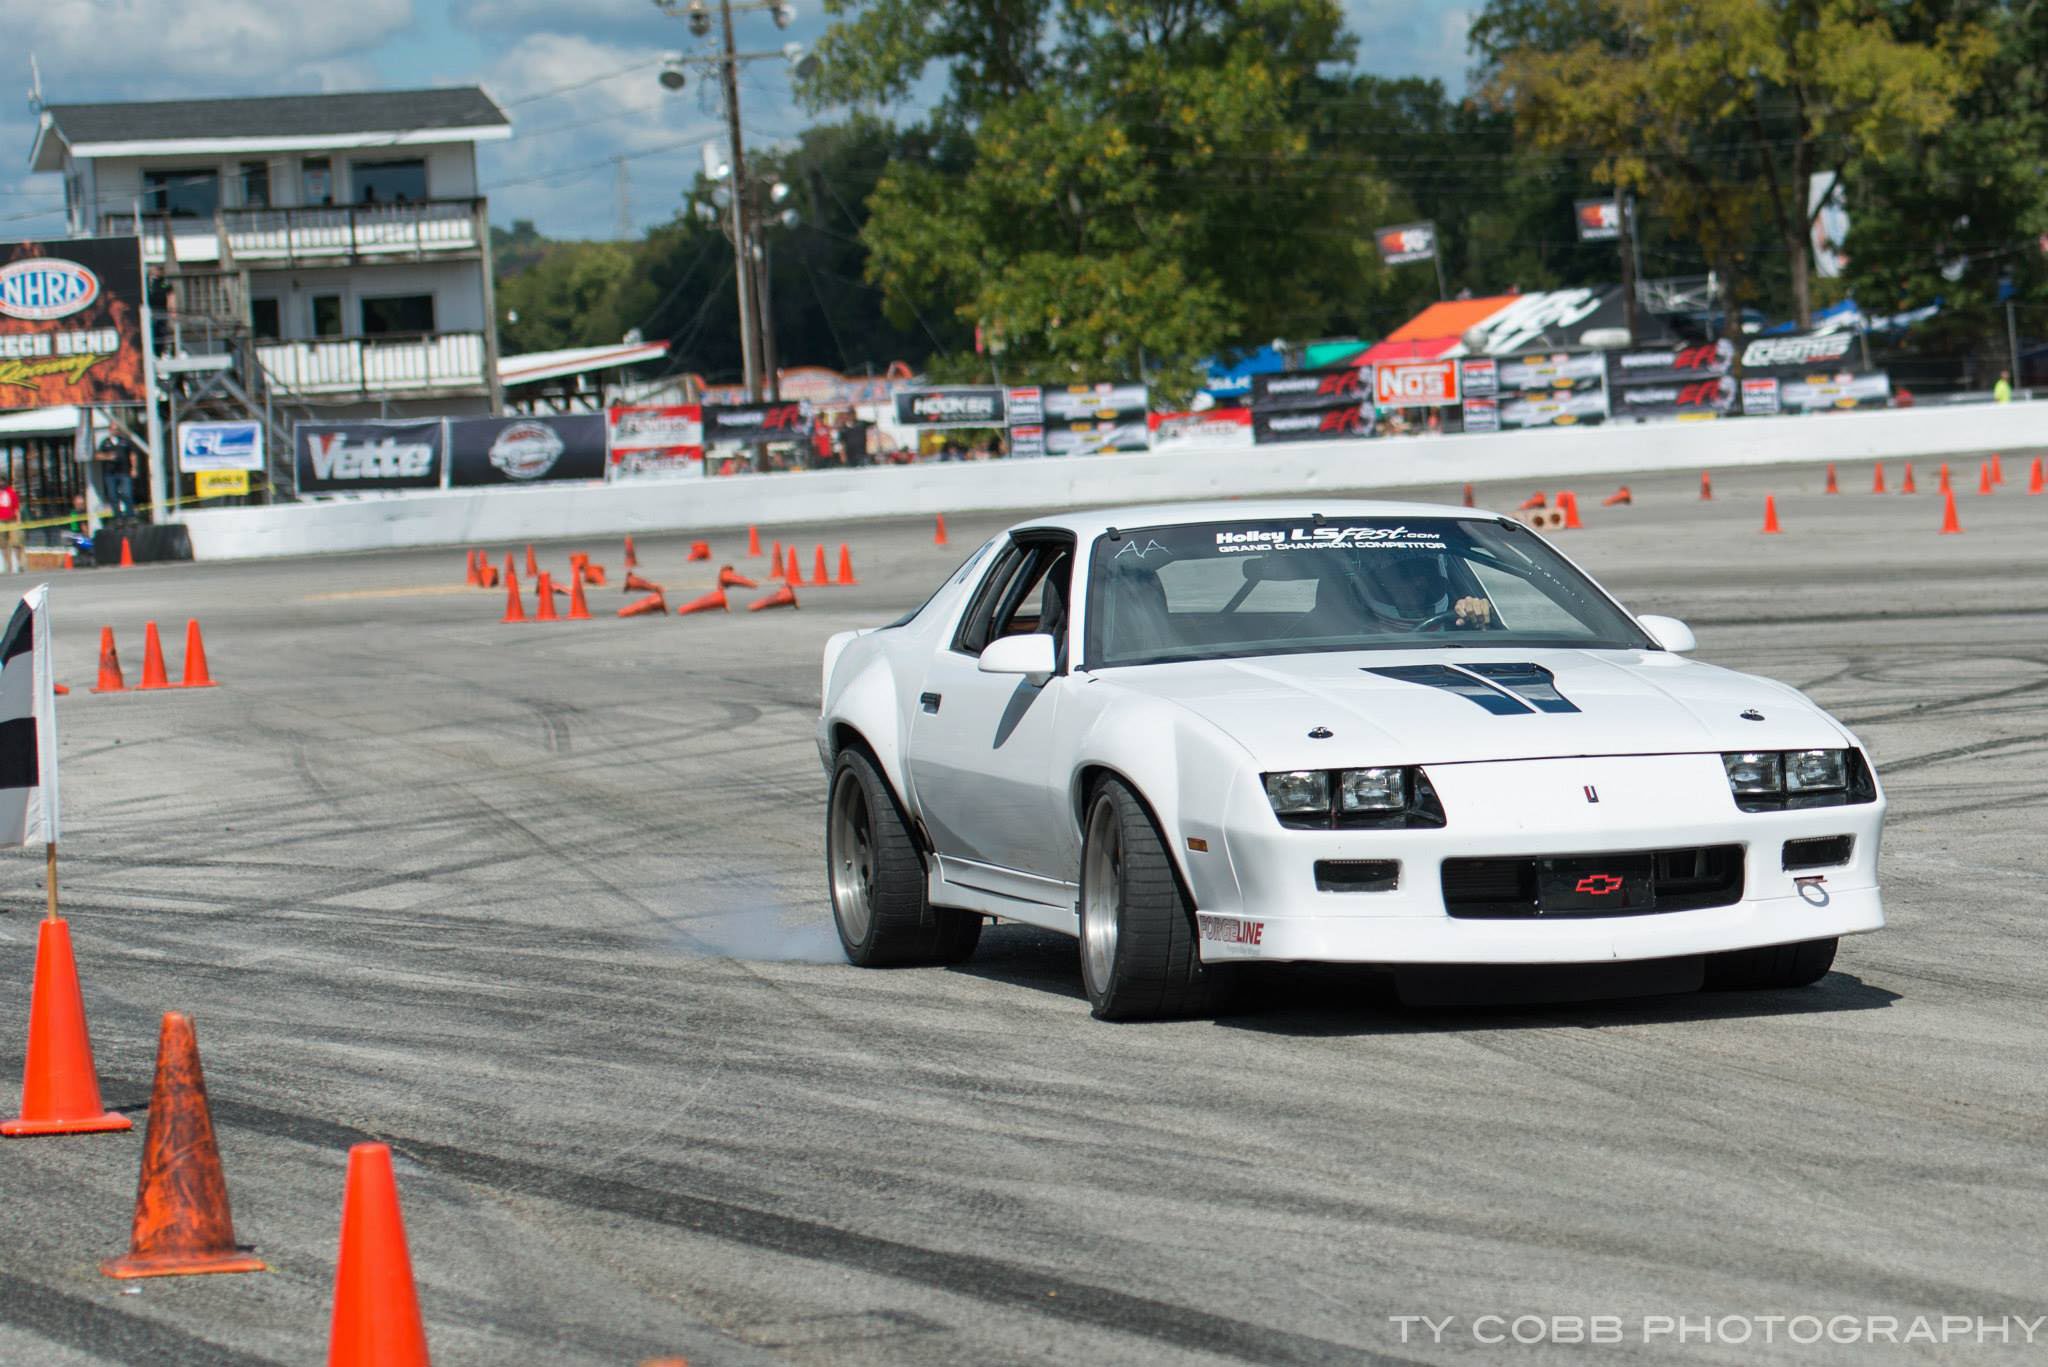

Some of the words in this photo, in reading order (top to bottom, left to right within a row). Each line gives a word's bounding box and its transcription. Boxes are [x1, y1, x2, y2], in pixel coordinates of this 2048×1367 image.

[4, 271, 83, 306] NHRA
[55, 326, 119, 355] BEND
[913, 396, 993, 416] HOOKER
[307, 431, 433, 480] Vette
[1216, 530, 1286, 544] Holley
[1218, 544, 1272, 553] GRAND
[1275, 541, 1352, 550] CHAMPION
[1354, 541, 1448, 549] COMPETITOR
